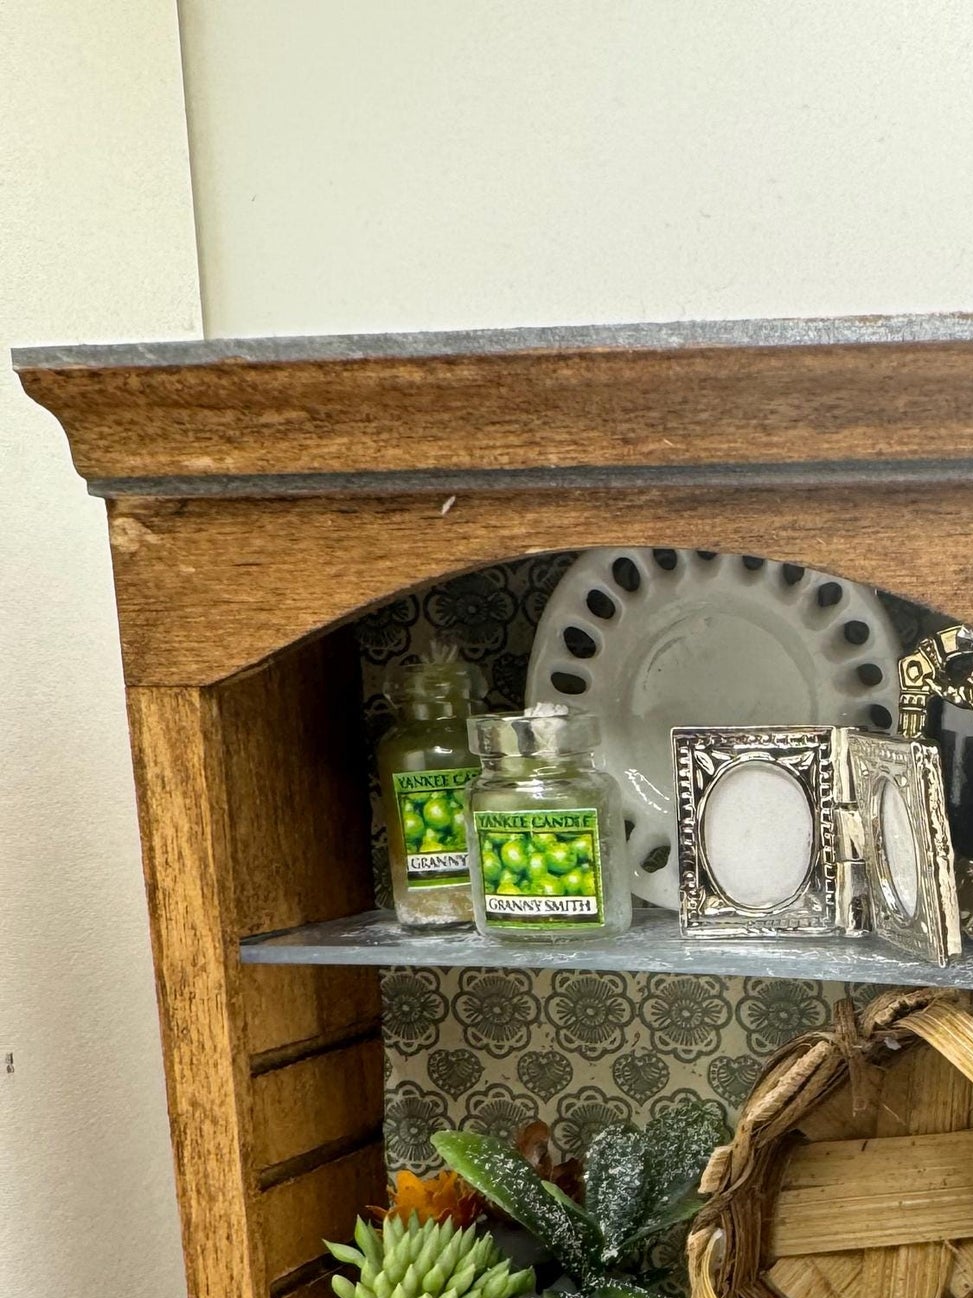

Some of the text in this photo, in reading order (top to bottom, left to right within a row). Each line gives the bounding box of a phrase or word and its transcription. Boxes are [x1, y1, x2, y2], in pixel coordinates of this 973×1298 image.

[399, 774, 449, 789] YANKEE
[479, 815, 590, 828] YANKEE CANDLE
[411, 854, 467, 870] GRANNY
[489, 898, 591, 912] GRANNY SMITH
